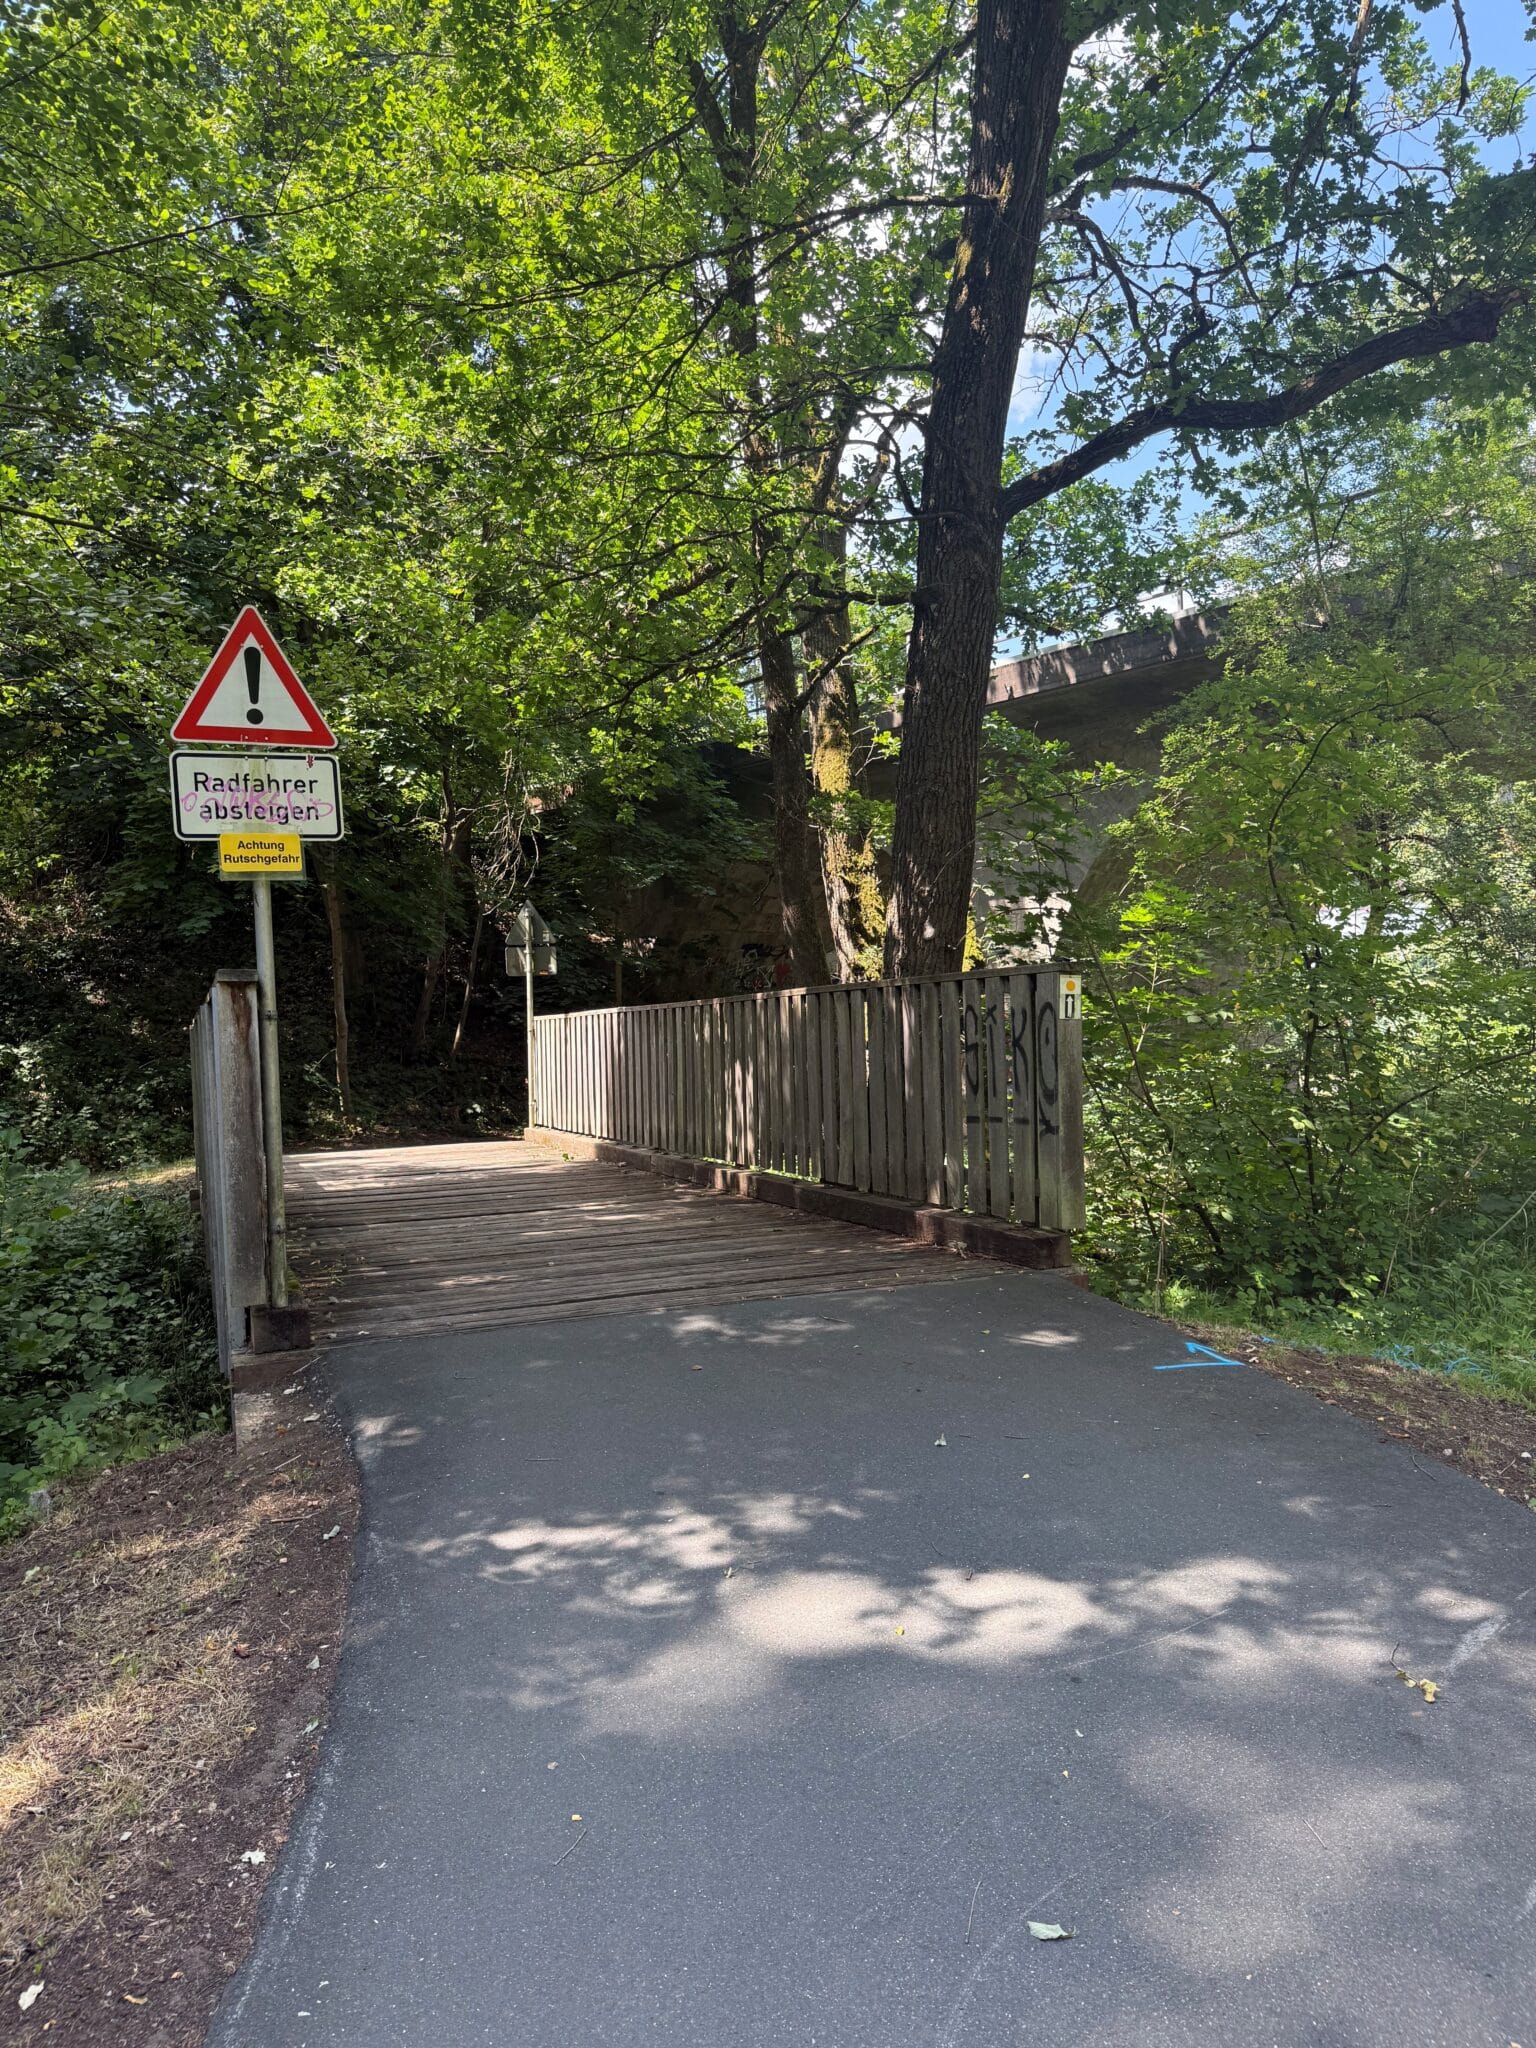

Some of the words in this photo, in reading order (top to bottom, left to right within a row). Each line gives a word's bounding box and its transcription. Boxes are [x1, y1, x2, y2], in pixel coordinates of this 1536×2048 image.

[193, 772, 318, 794] Radfahrer
[200, 801, 319, 824] absteigen
[237, 840, 285, 851] Achtung
[223, 853, 300, 865] Rutschgefahr
